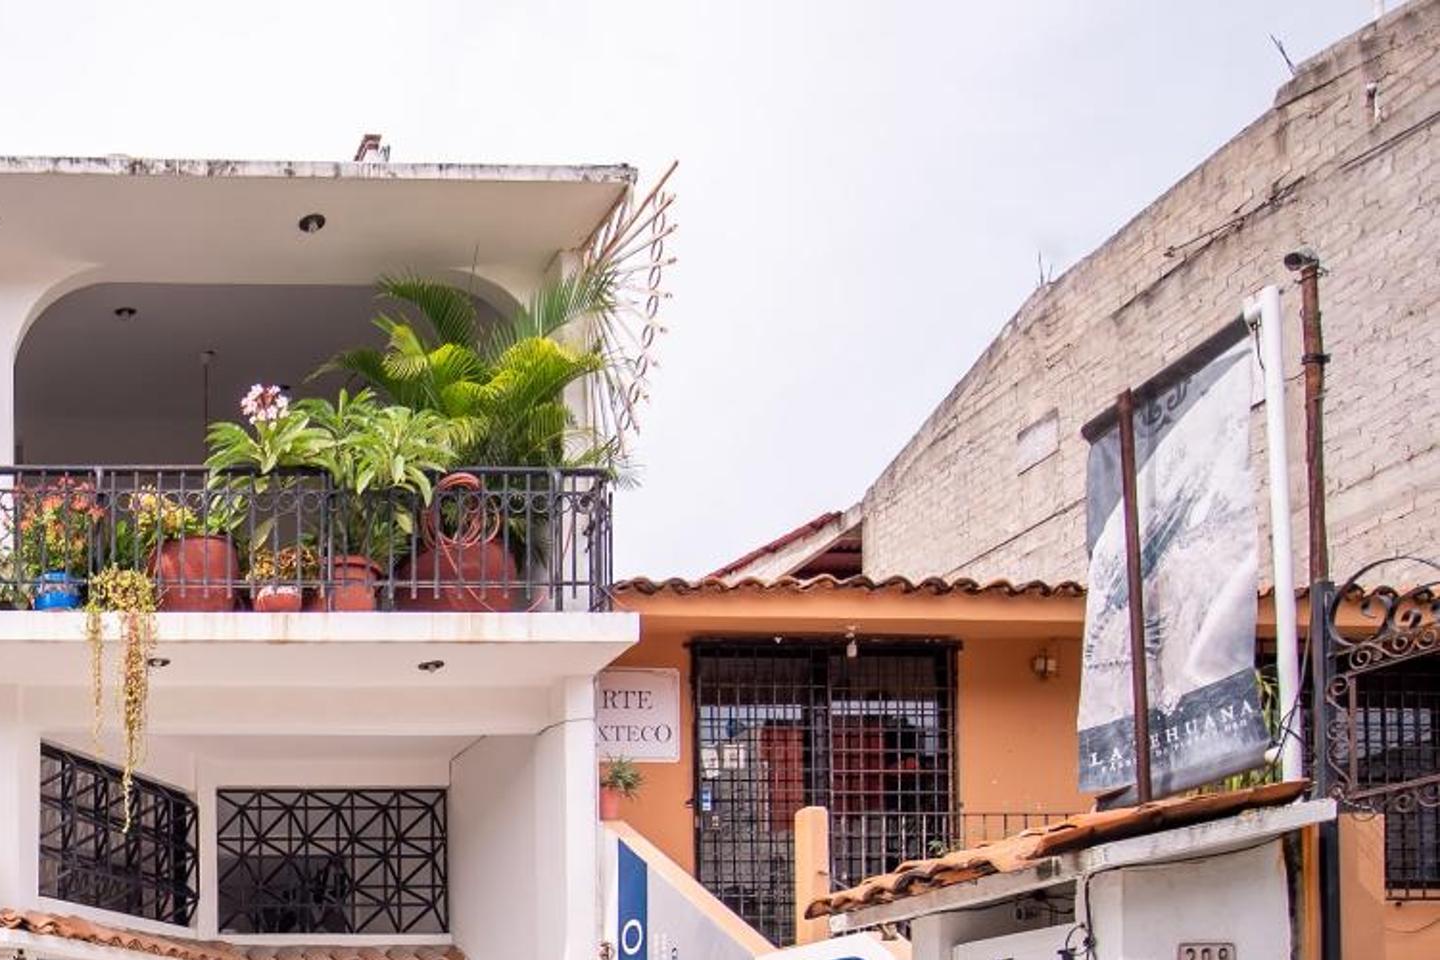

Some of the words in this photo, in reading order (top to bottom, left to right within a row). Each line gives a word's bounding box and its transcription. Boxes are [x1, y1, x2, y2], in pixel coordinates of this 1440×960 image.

[1089, 746, 1123, 766] LA
[1133, 700, 1253, 750] EHUANA
[622, 919, 643, 955] O
